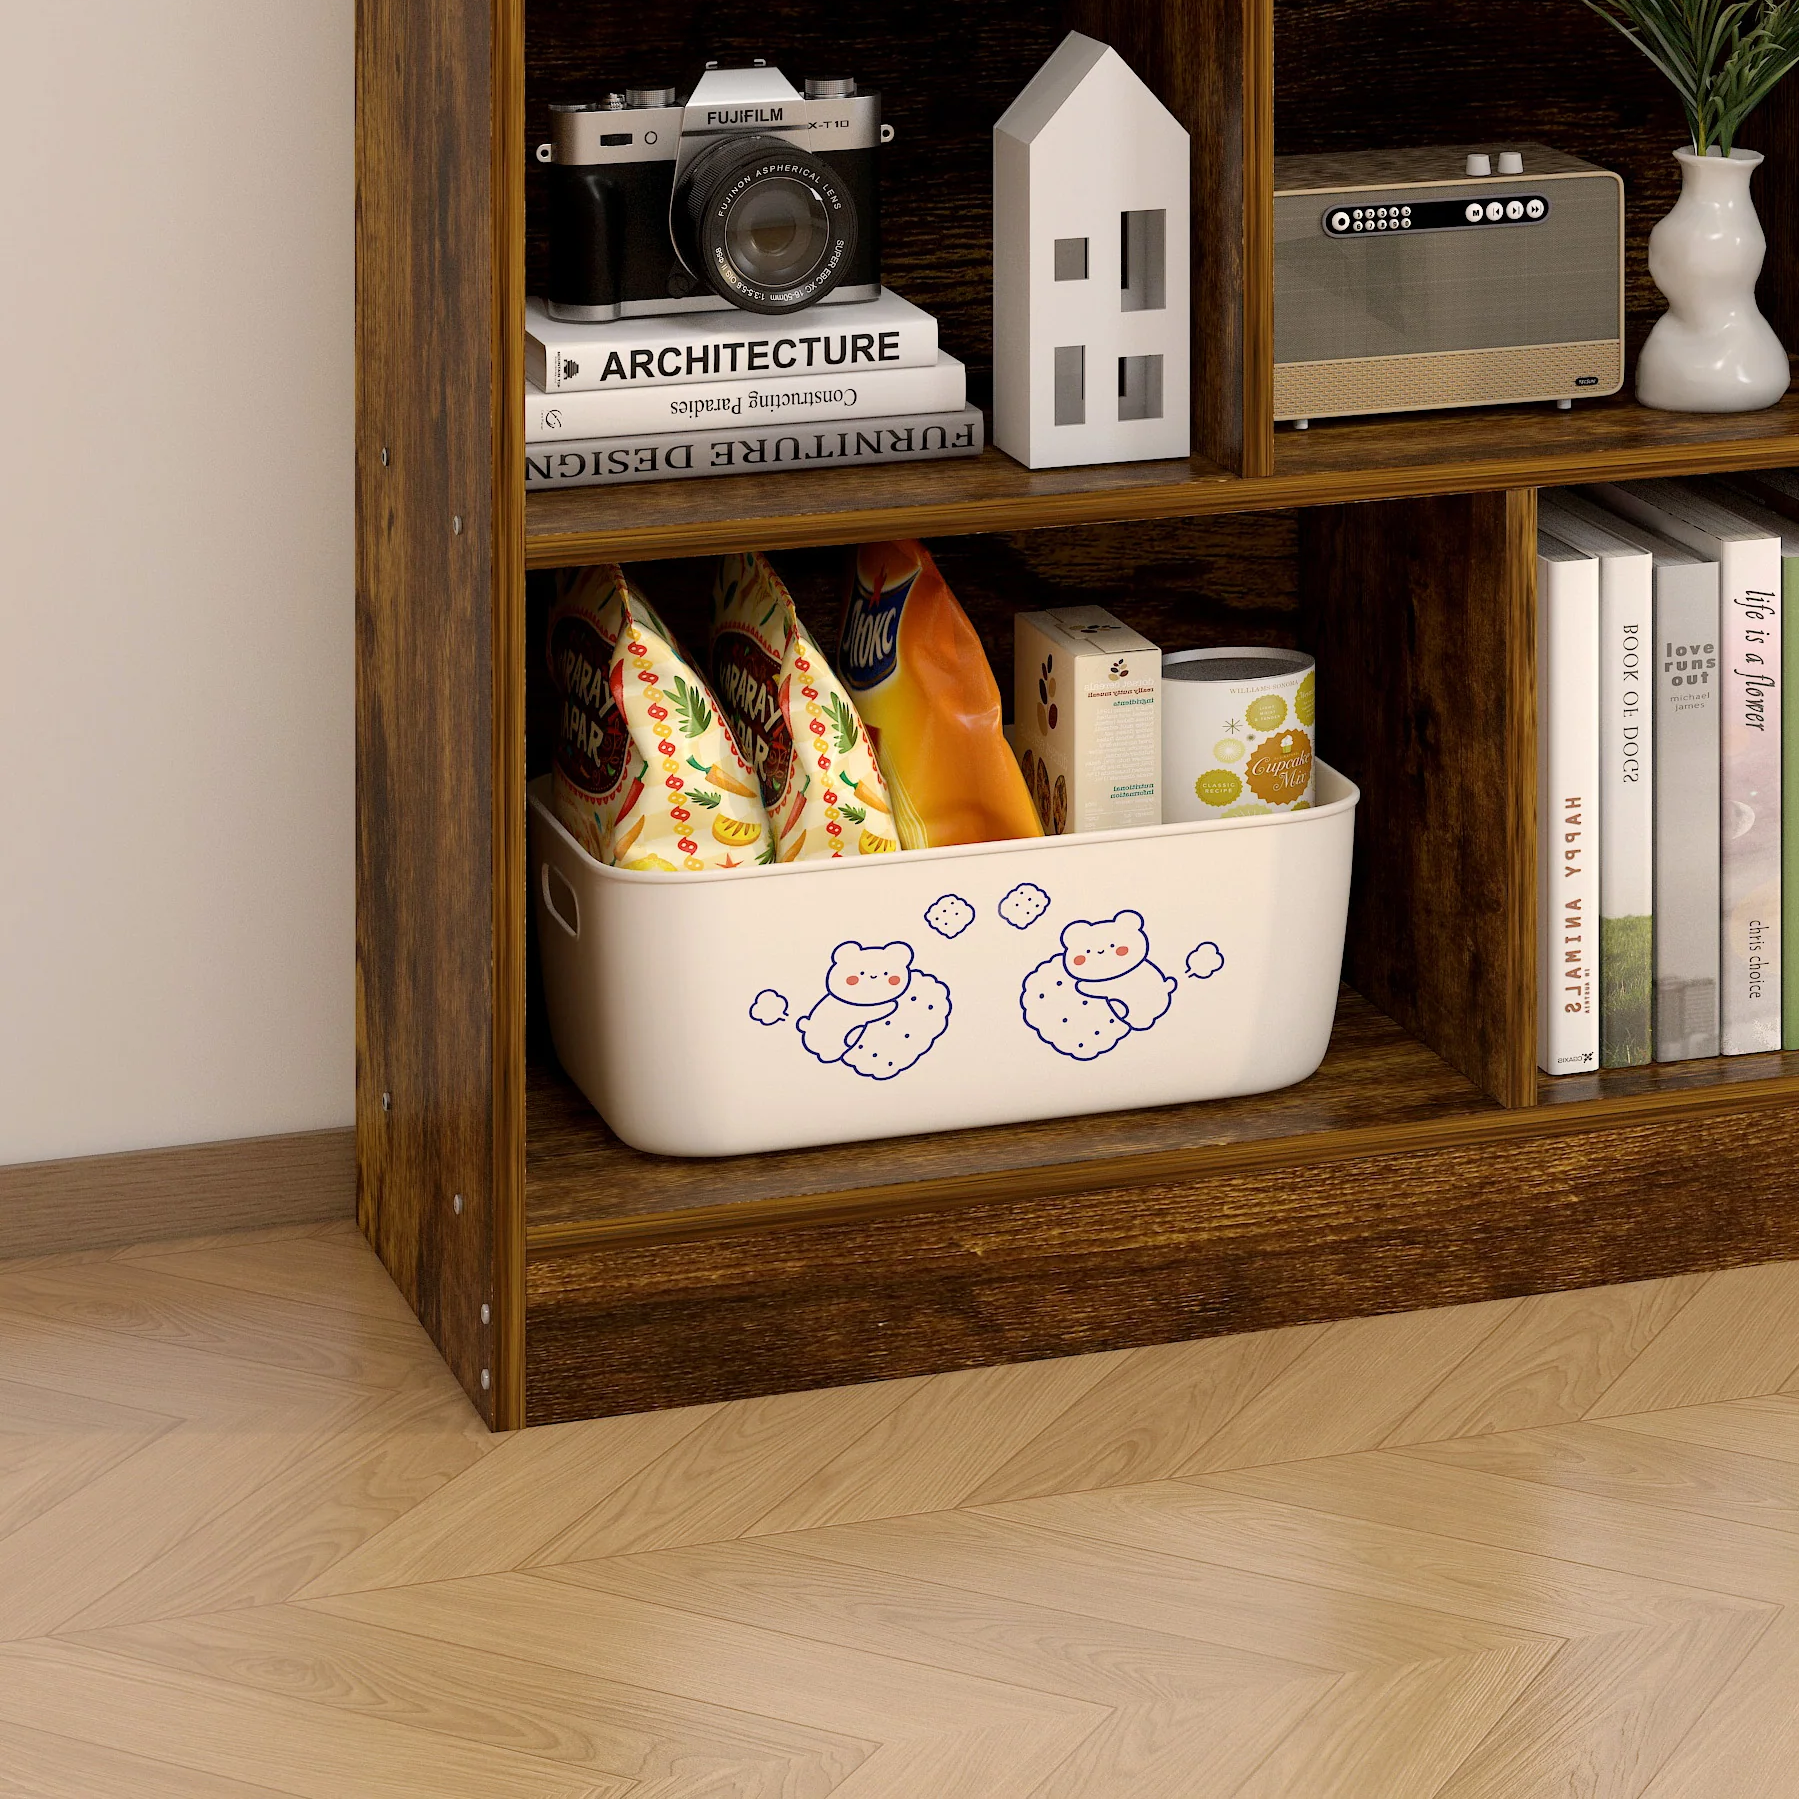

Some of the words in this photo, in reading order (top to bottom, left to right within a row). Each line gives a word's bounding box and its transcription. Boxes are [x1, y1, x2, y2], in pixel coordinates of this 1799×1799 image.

[707, 107, 783, 125] FUJIFILM
[717, 175, 751, 217] FUJINON
[755, 164, 819, 184] ASPHERICAL
[822, 183, 842, 210] LENS
[827, 239, 845, 269] SUPER
[804, 281, 818, 294] XC
[815, 268, 832, 284] EBC
[600, 330, 900, 382] ARCHITECTURE
[670, 396, 742, 419] Paradies
[748, 388, 857, 411] Constructing
[711, 423, 976, 467] FURNITURE
[525, 444, 693, 480] DESIGN
[1734, 590, 1775, 620] life
[1745, 629, 1770, 643] is
[1666, 642, 1714, 657] love
[1664, 657, 1716, 672] runs
[1671, 671, 1709, 687] out
[1670, 692, 1710, 702] michael
[1675, 702, 1705, 712] james
[1734, 669, 1775, 731] flower
[1252, 750, 1311, 777] Cupcake
[1272, 770, 1307, 792] Mix
[1749, 920, 1769, 951] chris
[1749, 956, 1769, 999] choice
